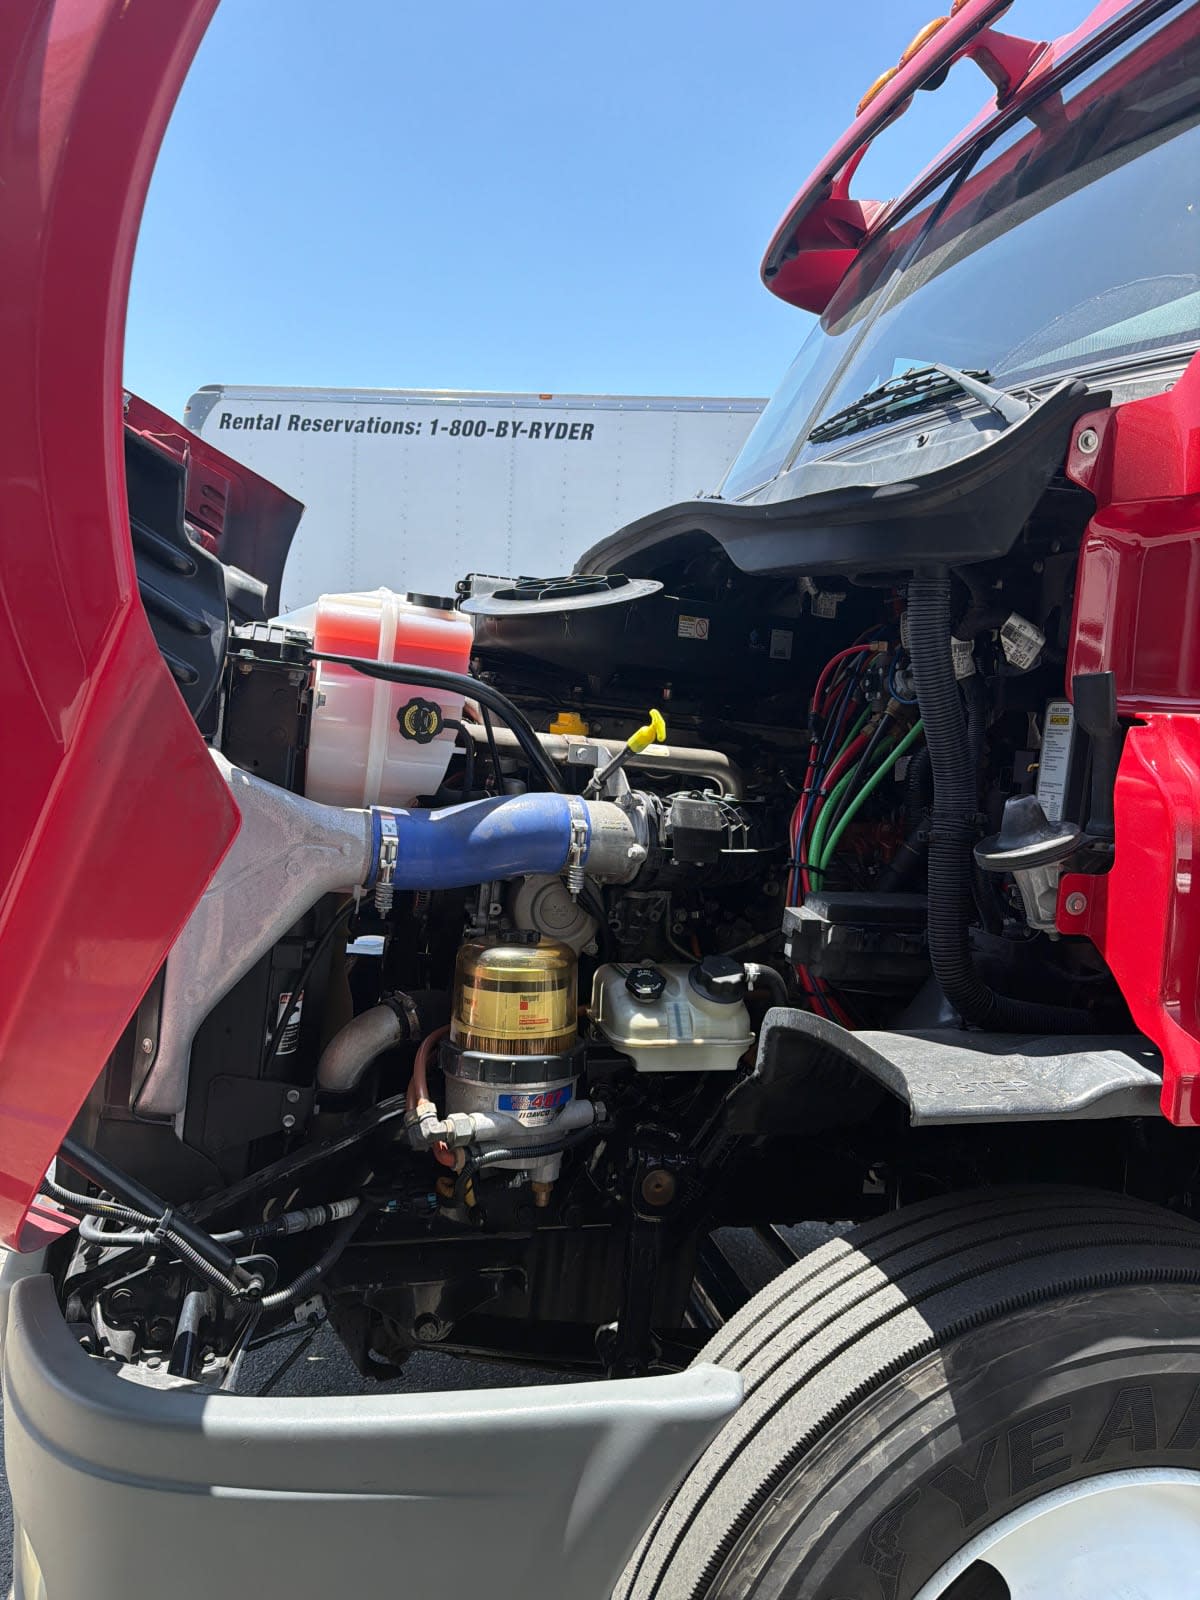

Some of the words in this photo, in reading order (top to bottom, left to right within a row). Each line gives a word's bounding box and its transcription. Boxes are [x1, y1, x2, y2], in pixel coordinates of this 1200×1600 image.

[219, 412, 282, 431] Rental
[287, 414, 422, 436] Reservations:
[429, 418, 595, 441] 1-800-BY-RYDER
